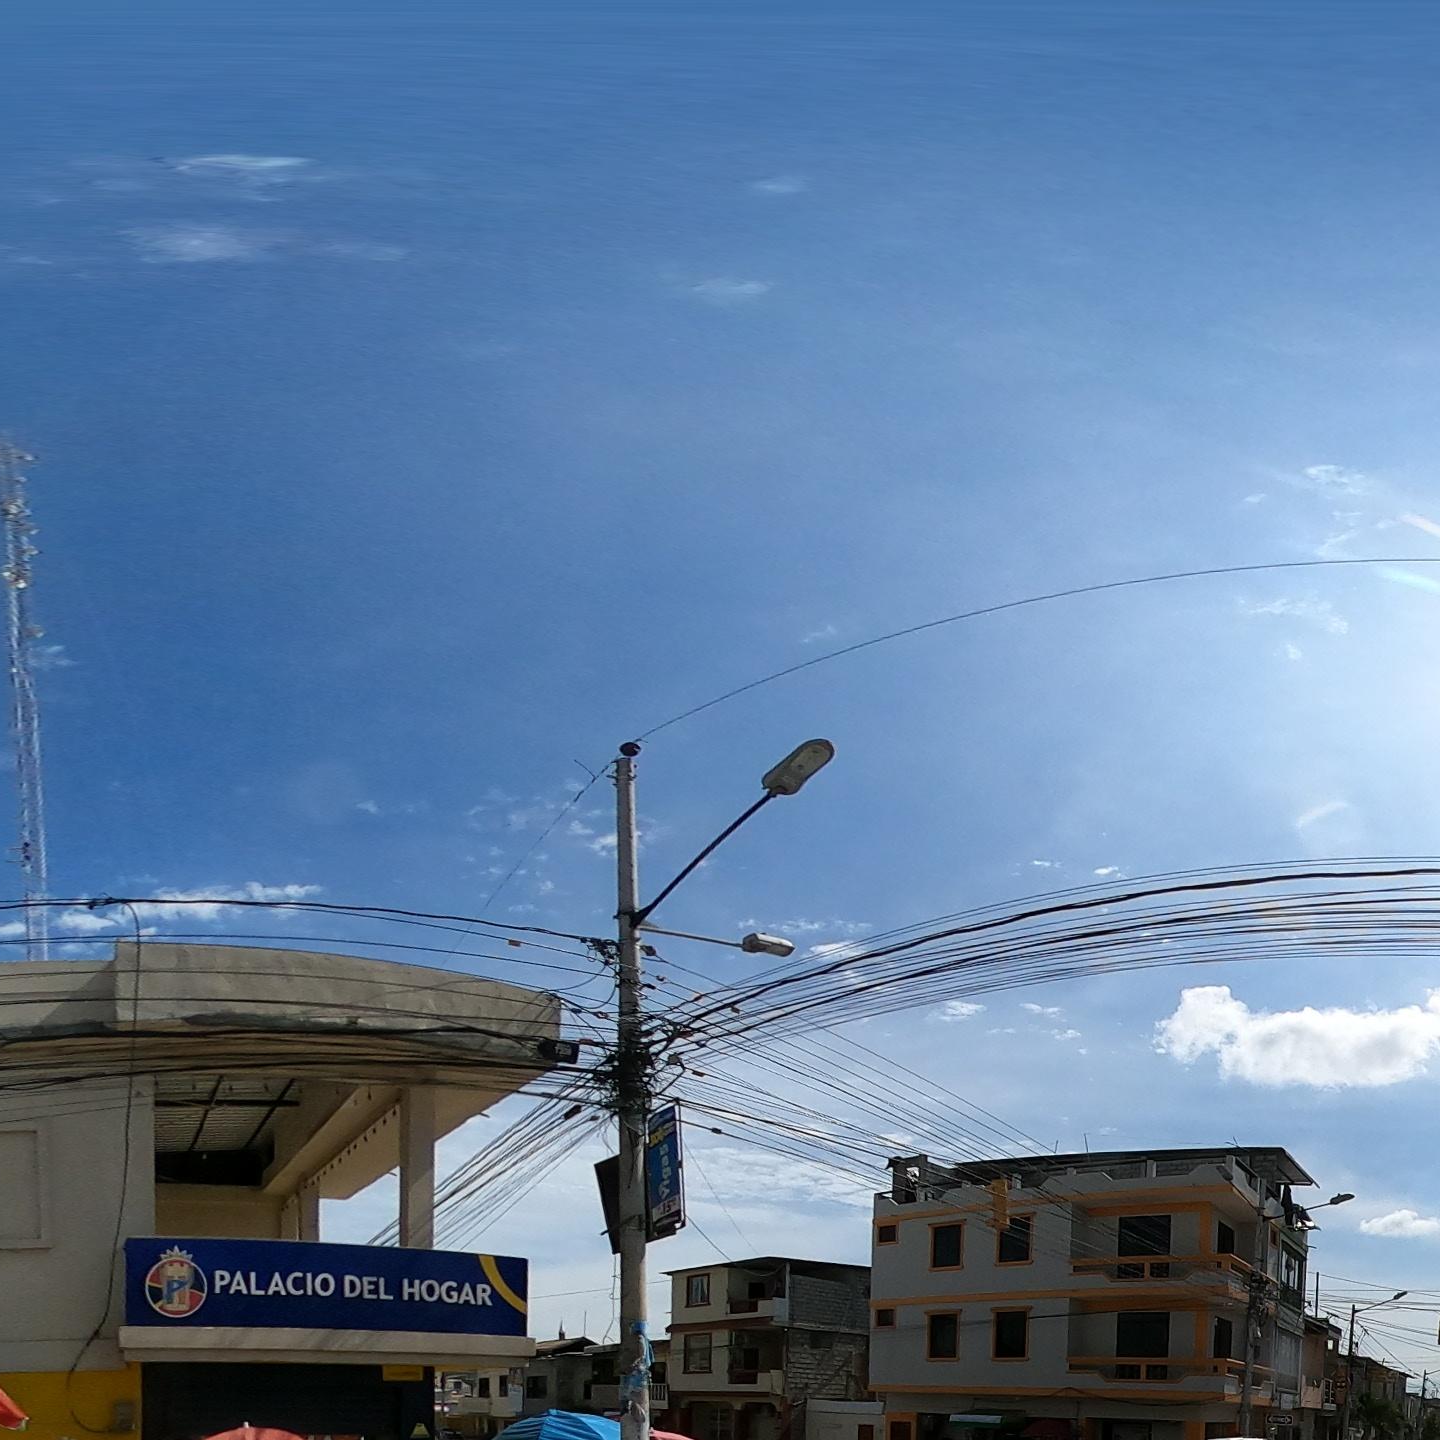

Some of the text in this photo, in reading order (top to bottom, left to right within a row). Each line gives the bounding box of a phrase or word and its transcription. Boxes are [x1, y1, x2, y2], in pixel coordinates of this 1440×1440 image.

[213, 1270, 493, 1306] PALACIO DEL HOGAR
